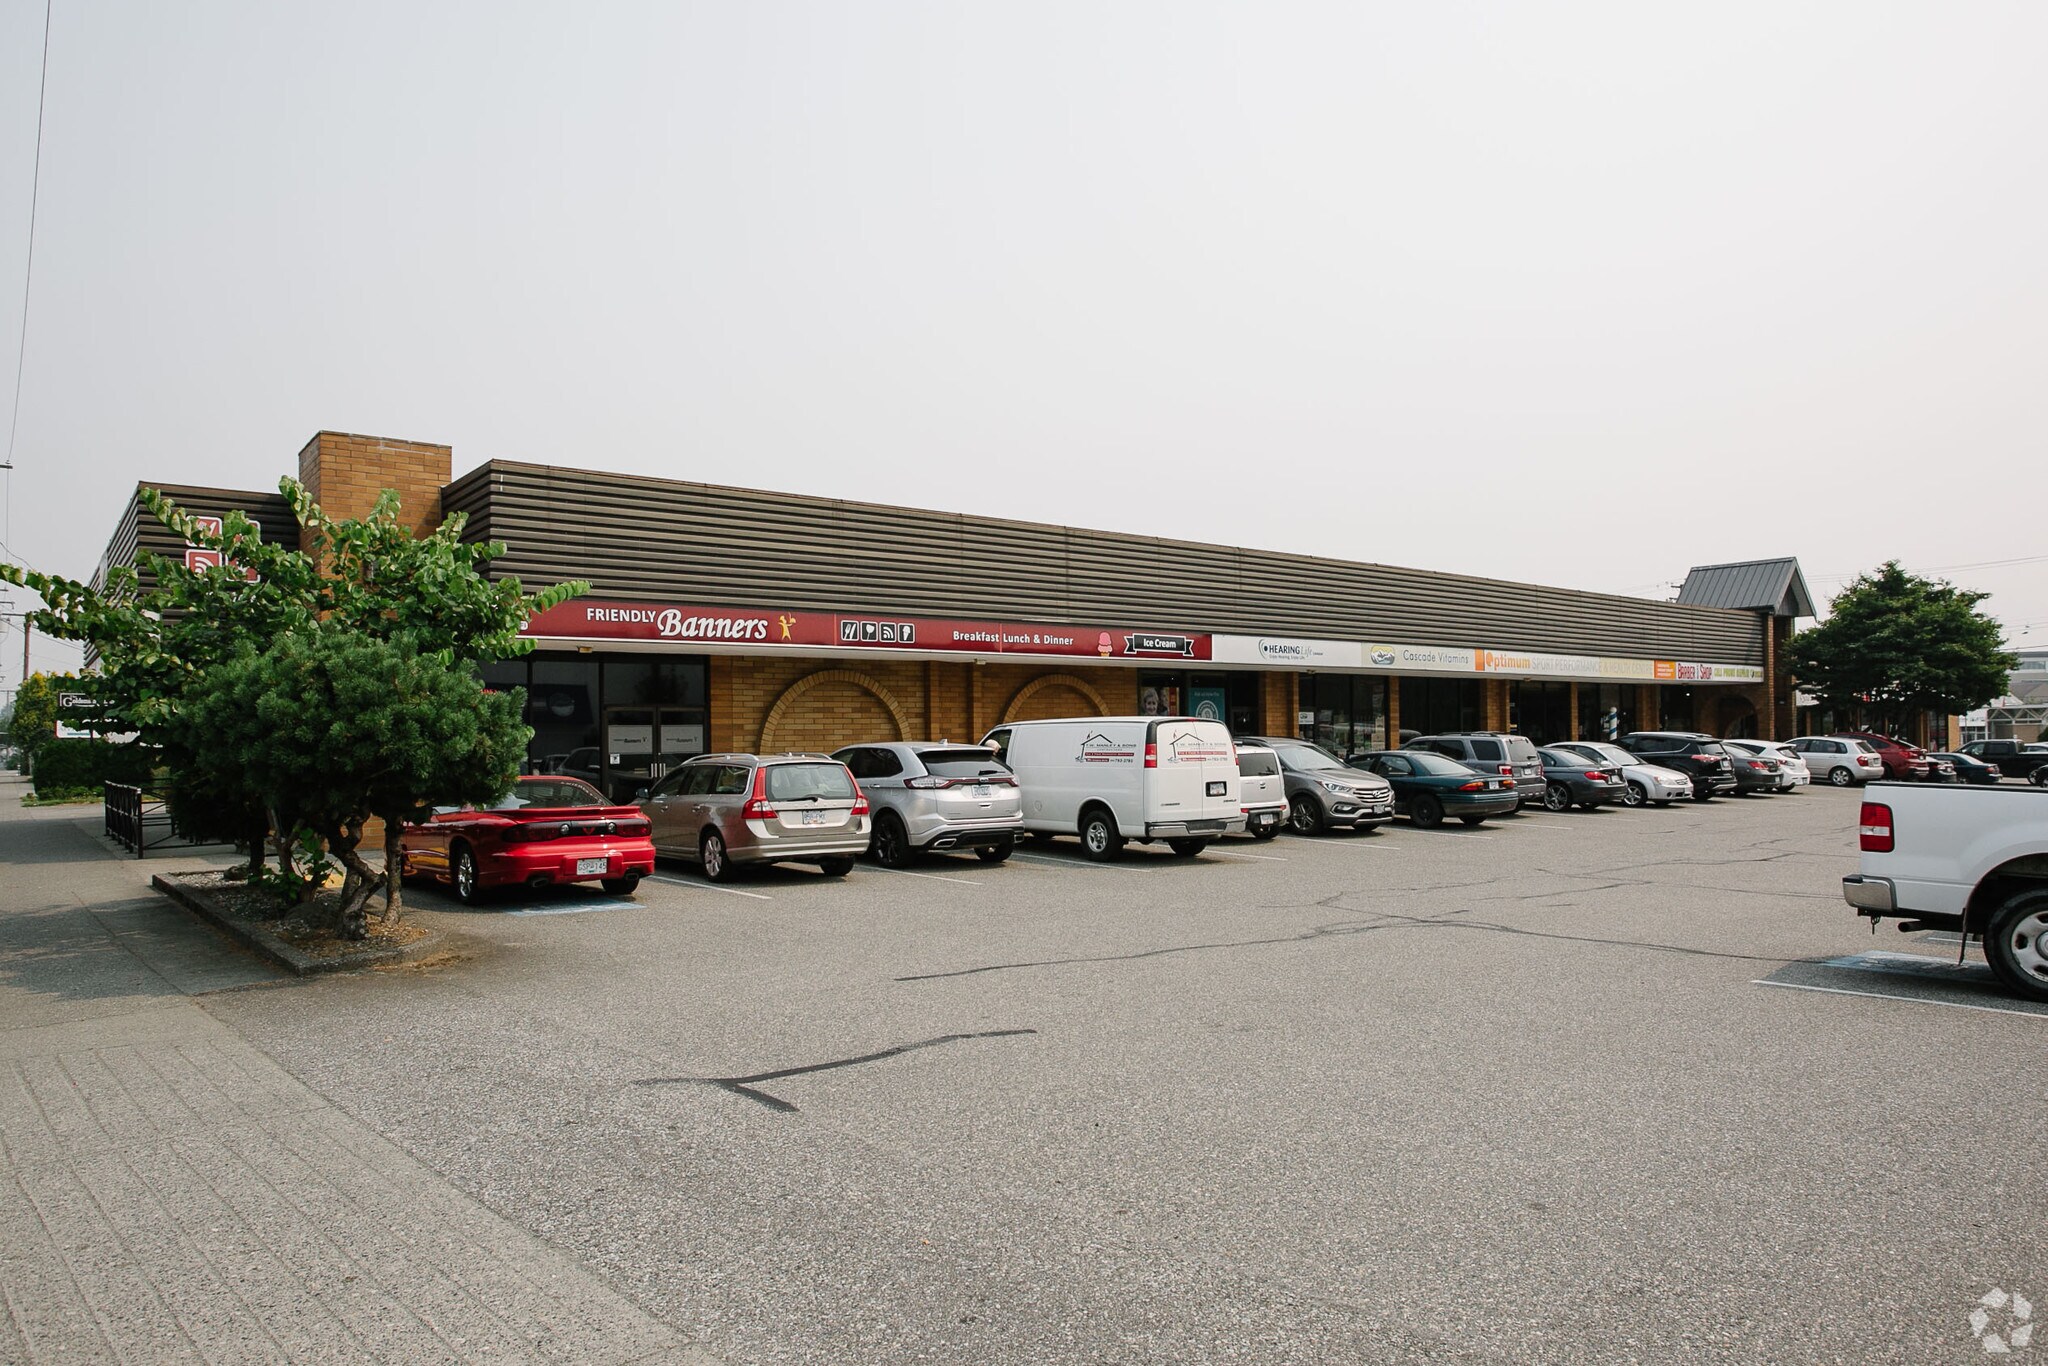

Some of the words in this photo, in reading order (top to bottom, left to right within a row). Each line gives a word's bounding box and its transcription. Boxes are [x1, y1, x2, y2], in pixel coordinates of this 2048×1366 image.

[586, 608, 656, 623] FRIENDLY
[656, 608, 768, 640] Banners
[953, 631, 999, 642] Breakfast
[1003, 633, 1030, 644] Lunch
[1033, 635, 1041, 645] &
[1043, 635, 1074, 646] Dinner
[1143, 638, 1153, 648] Ice
[1154, 639, 1177, 649] Cream
[1403, 649, 1436, 662] Cascade
[1438, 651, 1469, 665] Vitamins
[1486, 652, 1531, 670] Optimum
[1532, 657, 1554, 671] SPORT
